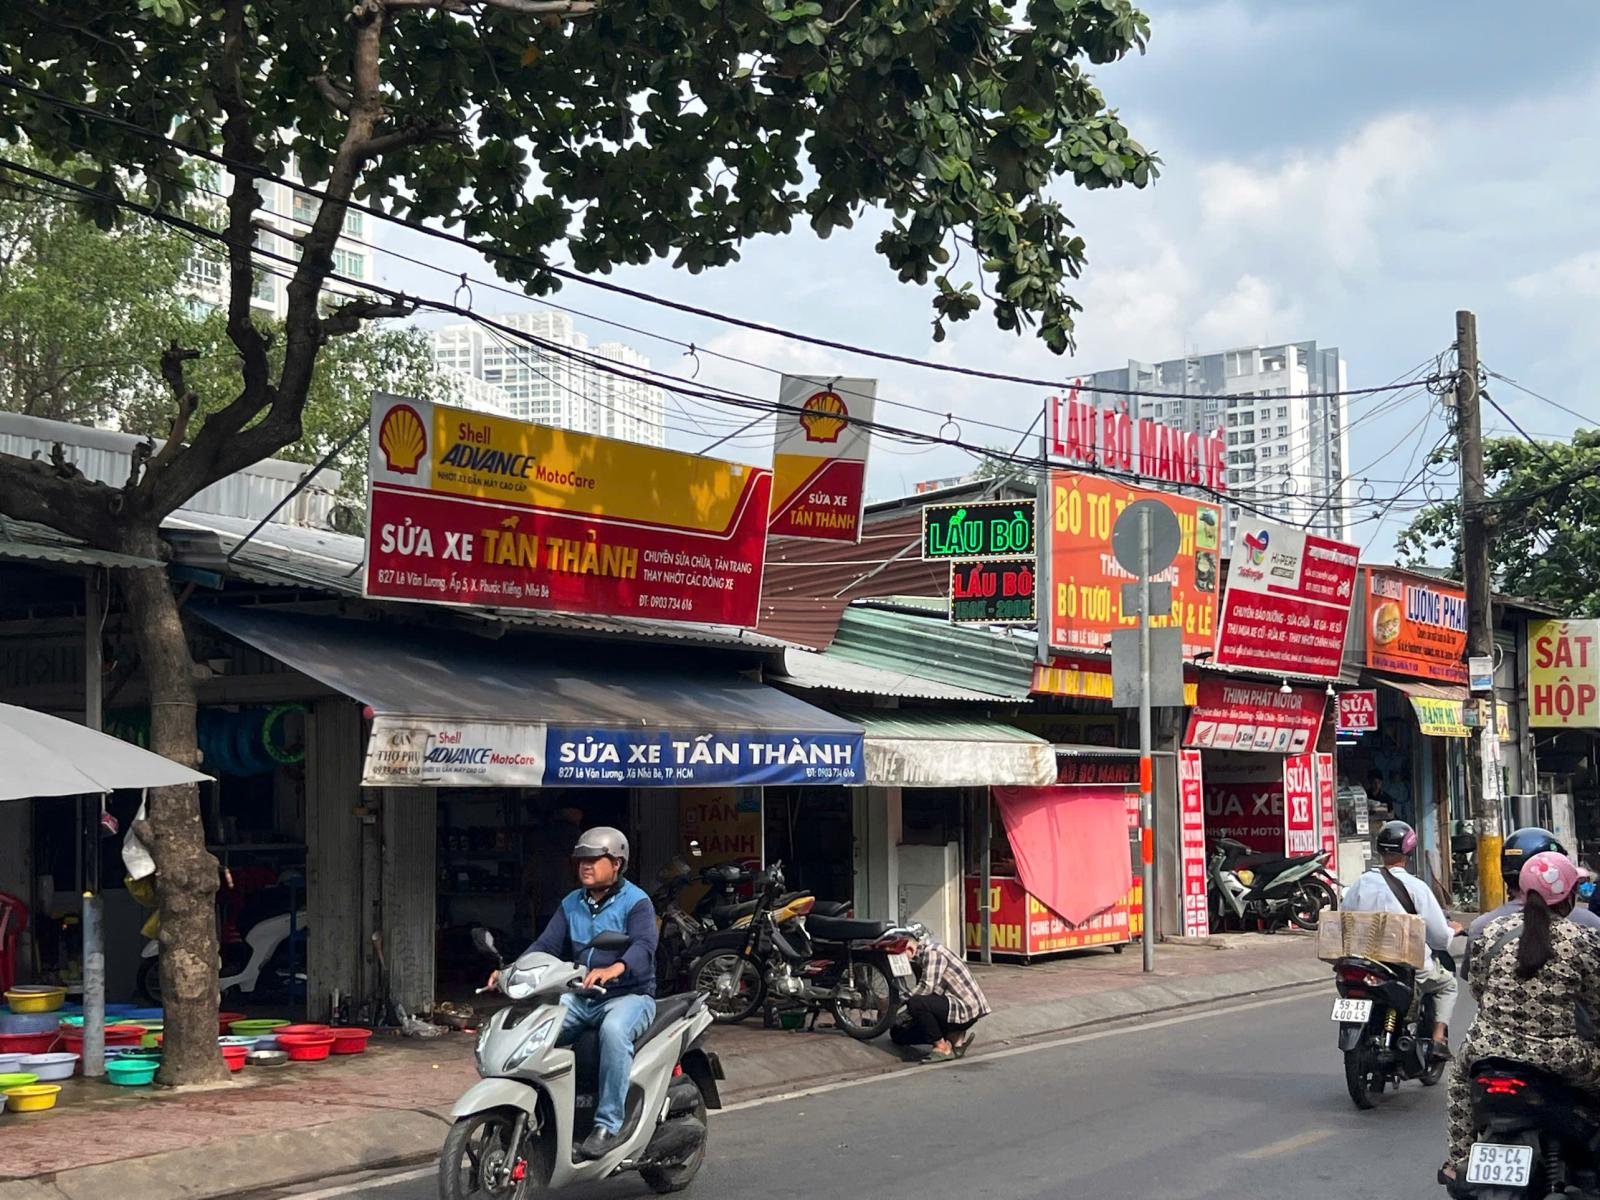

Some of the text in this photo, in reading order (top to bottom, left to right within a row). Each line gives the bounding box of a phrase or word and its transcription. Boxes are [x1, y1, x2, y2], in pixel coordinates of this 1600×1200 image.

[458, 422, 491, 444] Shell
[1103, 400, 1132, 471] BÒ
[1139, 418, 1200, 485] MANG
[1204, 424, 1227, 492] VỀ
[439, 443, 536, 479] ADVANCE
[536, 467, 596, 489] MotoCare
[808, 490, 848, 506] SỬA XE
[1055, 478, 1082, 535] BÒ
[1087, 492, 1111, 541] TƠ
[790, 504, 856, 529] TẤN THÀNH
[380, 516, 434, 558] SỬA
[442, 531, 474, 562] XE
[990, 510, 1029, 552] BÒ
[643, 549, 674, 564] CHUYÊN
[674, 552, 690, 567] SỬA
[691, 554, 713, 570] CHỮA,
[730, 560, 753, 574] TRANG
[378, 569, 394, 584] 827
[396, 570, 405, 584] Lê
[407, 571, 423, 586] Văn
[449, 571, 461, 593] Ấp
[480, 579, 501, 593] Phước
[541, 584, 549, 598] Bè
[643, 569, 734, 590] THAY NHỚT CÁC DÒNG XE
[1003, 565, 1033, 597] BÒ
[639, 594, 649, 607] ĐT:
[650, 596, 668, 609] 0903
[668, 597, 681, 610] 734
[1057, 576, 1077, 618] BÒ
[1080, 585, 1110, 622] TƯƠI
[1186, 603, 1195, 634] &
[1198, 596, 1212, 636] LẺ
[1227, 623, 1238, 634] THU
[1238, 624, 1250, 636] MUA
[1535, 622, 1593, 669] SẮT
[1251, 687, 1273, 707] PHÁT
[1273, 692, 1303, 709] MOTOR
[1341, 694, 1373, 712] SỬA
[1534, 675, 1596, 723] HỘP
[1347, 713, 1369, 727] XE
[439, 731, 462, 744] Shell
[559, 733, 852, 765] SỬA XE TẤN THÀNH
[424, 747, 493, 764] ADVANCE
[490, 752, 536, 766] MotoCare
[558, 767, 574, 778] 827
[575, 767, 583, 778] Lê
[585, 767, 600, 778] Văn
[626, 768, 636, 778] Xã
[637, 767, 651, 778] Nhà
[676, 768, 694, 779] HCM
[1286, 759, 1312, 794] SỬA
[1205, 787, 1244, 817] ỬA
[1292, 796, 1309, 823] XE
[1288, 830, 1315, 859] THỊNH
[966, 921, 1021, 949] NNH
[1479, 1147, 1522, 1164] 59-C4
[1474, 1164, 1525, 1182] 109.25
